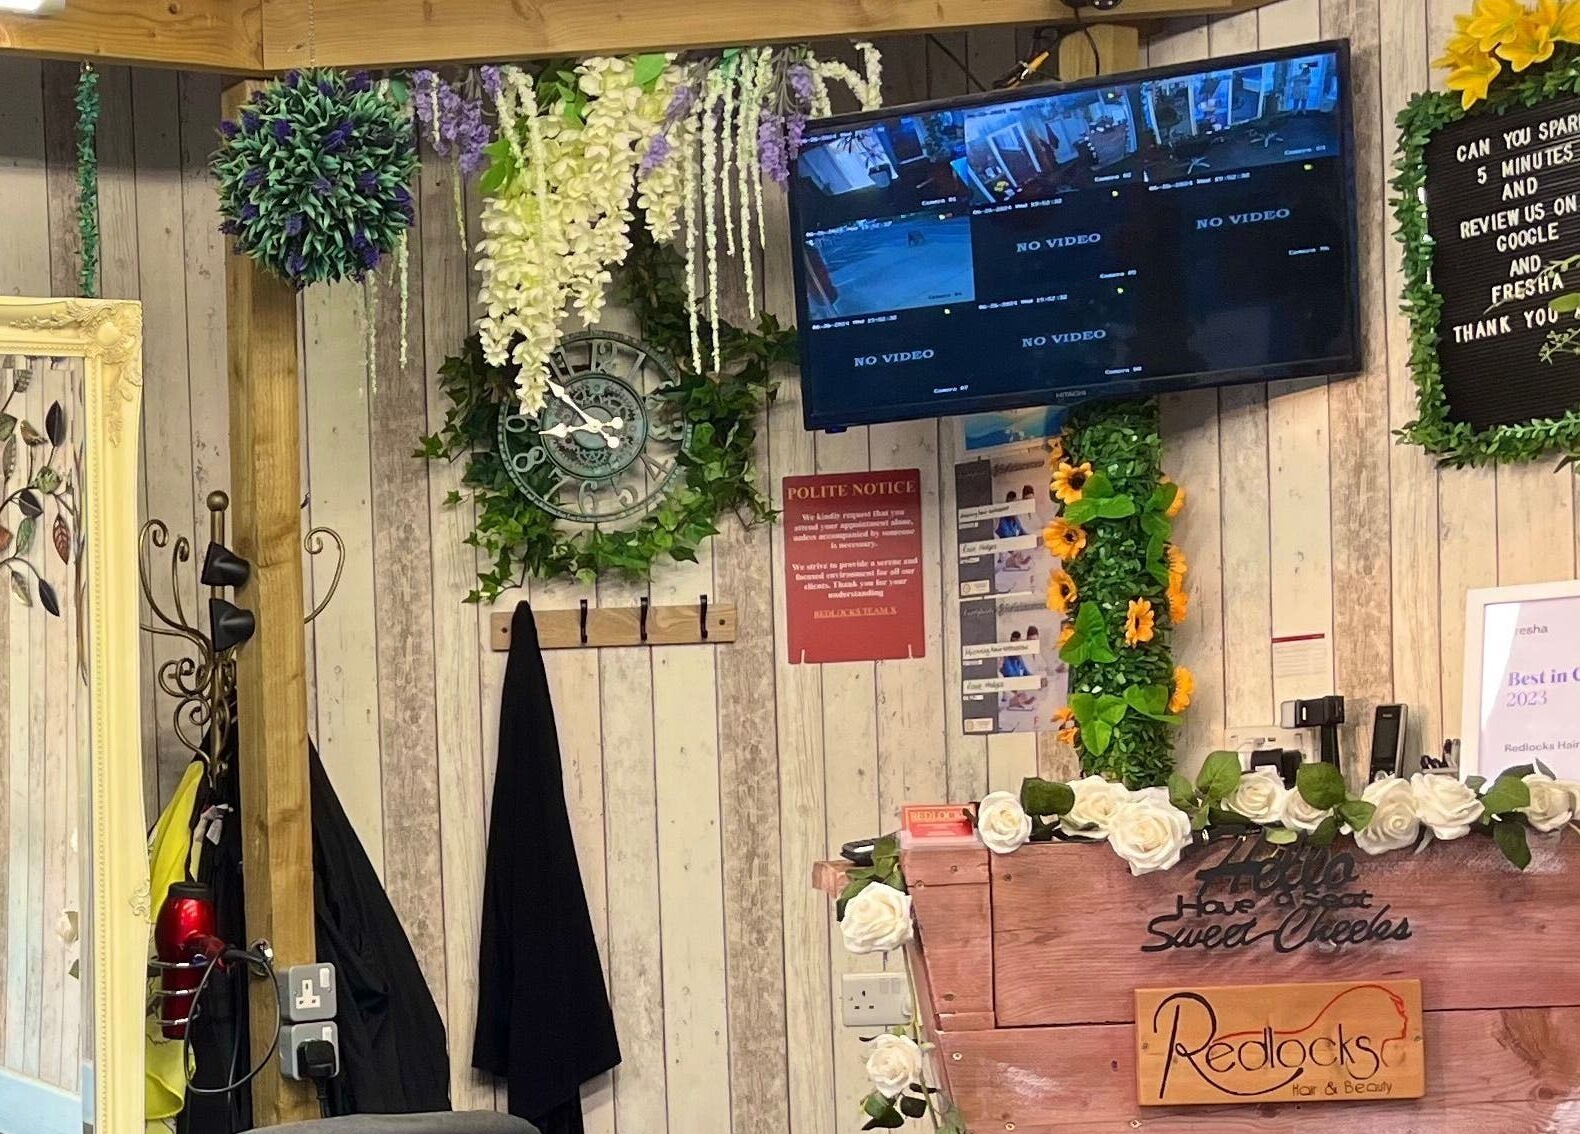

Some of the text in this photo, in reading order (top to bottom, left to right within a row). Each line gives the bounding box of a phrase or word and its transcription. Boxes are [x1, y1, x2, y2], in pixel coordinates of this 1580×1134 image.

[1456, 138, 1490, 162] CAN
[1503, 127, 1531, 150] YOU
[1477, 143, 1574, 184] 5 MINUTES
[1502, 177, 1538, 201] AND
[1196, 208, 1291, 230] NO VIDEO
[1460, 194, 1577, 239] REVIEW US ON
[1016, 232, 1101, 253] NO VIDEO
[1496, 222, 1559, 252] GOOGLE
[1510, 254, 1541, 278] AND
[1492, 273, 1564, 304] FRESHA
[1453, 316, 1511, 343] THANK
[1524, 307, 1558, 328] YOU
[1022, 329, 1106, 348] NO VIDEO
[854, 349, 934, 367] NO VIDEO
[788, 480, 915, 500] POLITE NOTICE
[816, 512, 840, 521] kindly
[842, 511, 870, 520] request
[873, 509, 888, 517] that
[818, 531, 868, 541] accompanied
[870, 530, 879, 538] by
[882, 528, 915, 536] someone
[821, 523, 837, 531] your
[840, 520, 889, 529] appointment
[807, 562, 828, 570] strive
[839, 560, 868, 570] provide
[826, 569, 875, 579] environment
[876, 568, 888, 576] for
[833, 579, 858, 588] Thank
[860, 580, 874, 588] you
[875, 578, 888, 586] for
[889, 578, 907, 586] your
[828, 590, 884, 599] understanding
[814, 607, 862, 618] REDLOCKS
[864, 606, 887, 616] TEAM
[1515, 624, 1548, 636] resha
[1508, 670, 1545, 686] Best
[1550, 669, 1568, 684] in
[1506, 691, 1548, 707] 2023
[1504, 738, 1580, 752] Redlocks Hair
[1177, 894, 1256, 918] Have
[1277, 891, 1293, 908] a
[1140, 904, 1412, 953] Sweet Cheeks
[1153, 992, 1380, 1099] Redlocks
[1292, 1080, 1394, 1097] Hair & Beauty
